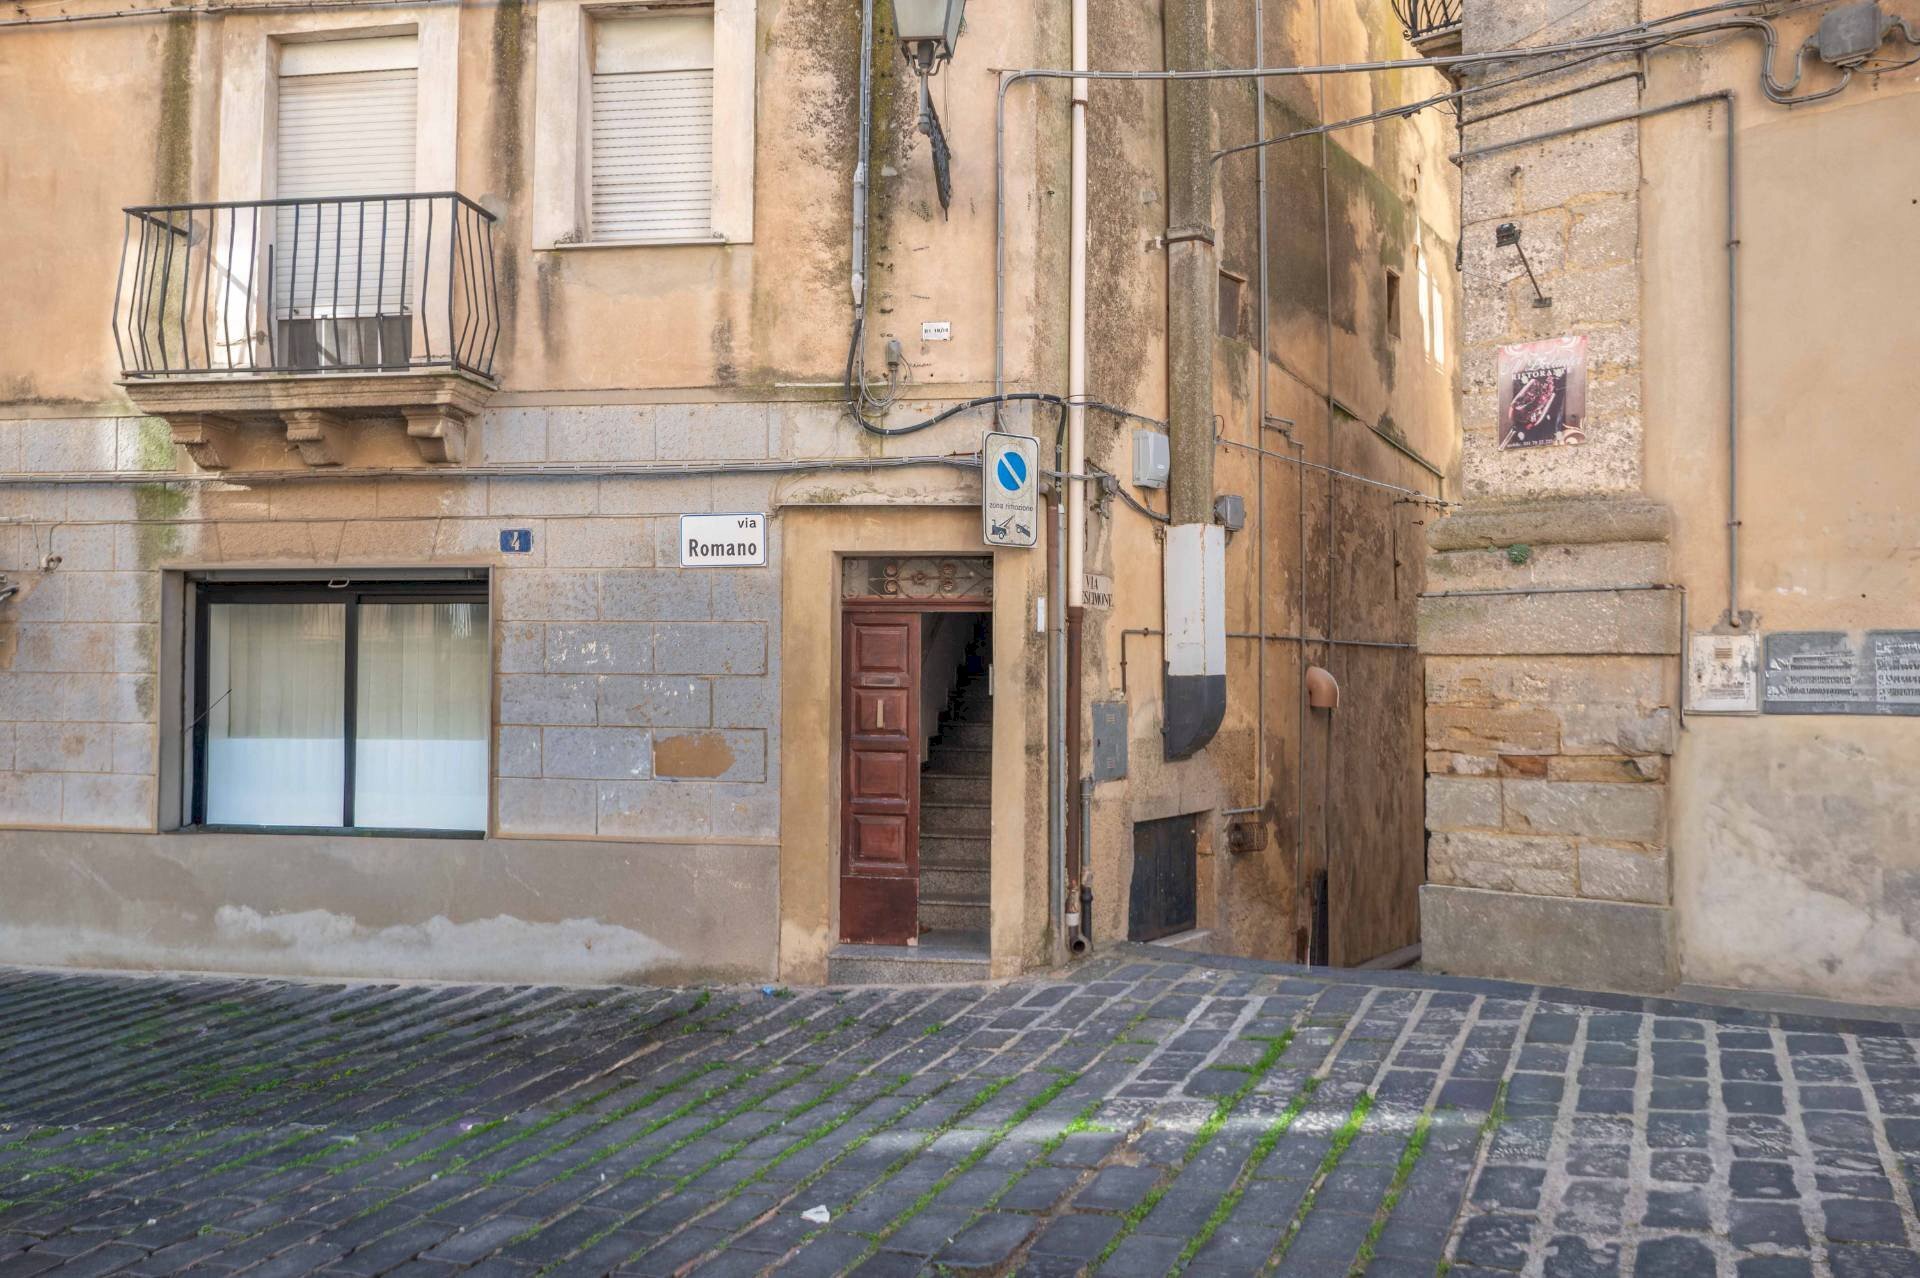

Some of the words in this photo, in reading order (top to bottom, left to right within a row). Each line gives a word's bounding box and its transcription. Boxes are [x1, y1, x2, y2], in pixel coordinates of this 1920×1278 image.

[1005, 502, 1034, 511] rimozione
[738, 517, 757, 529] via
[511, 531, 520, 551] 4
[689, 538, 757, 557] Romano
[1085, 575, 1099, 590] VIA
